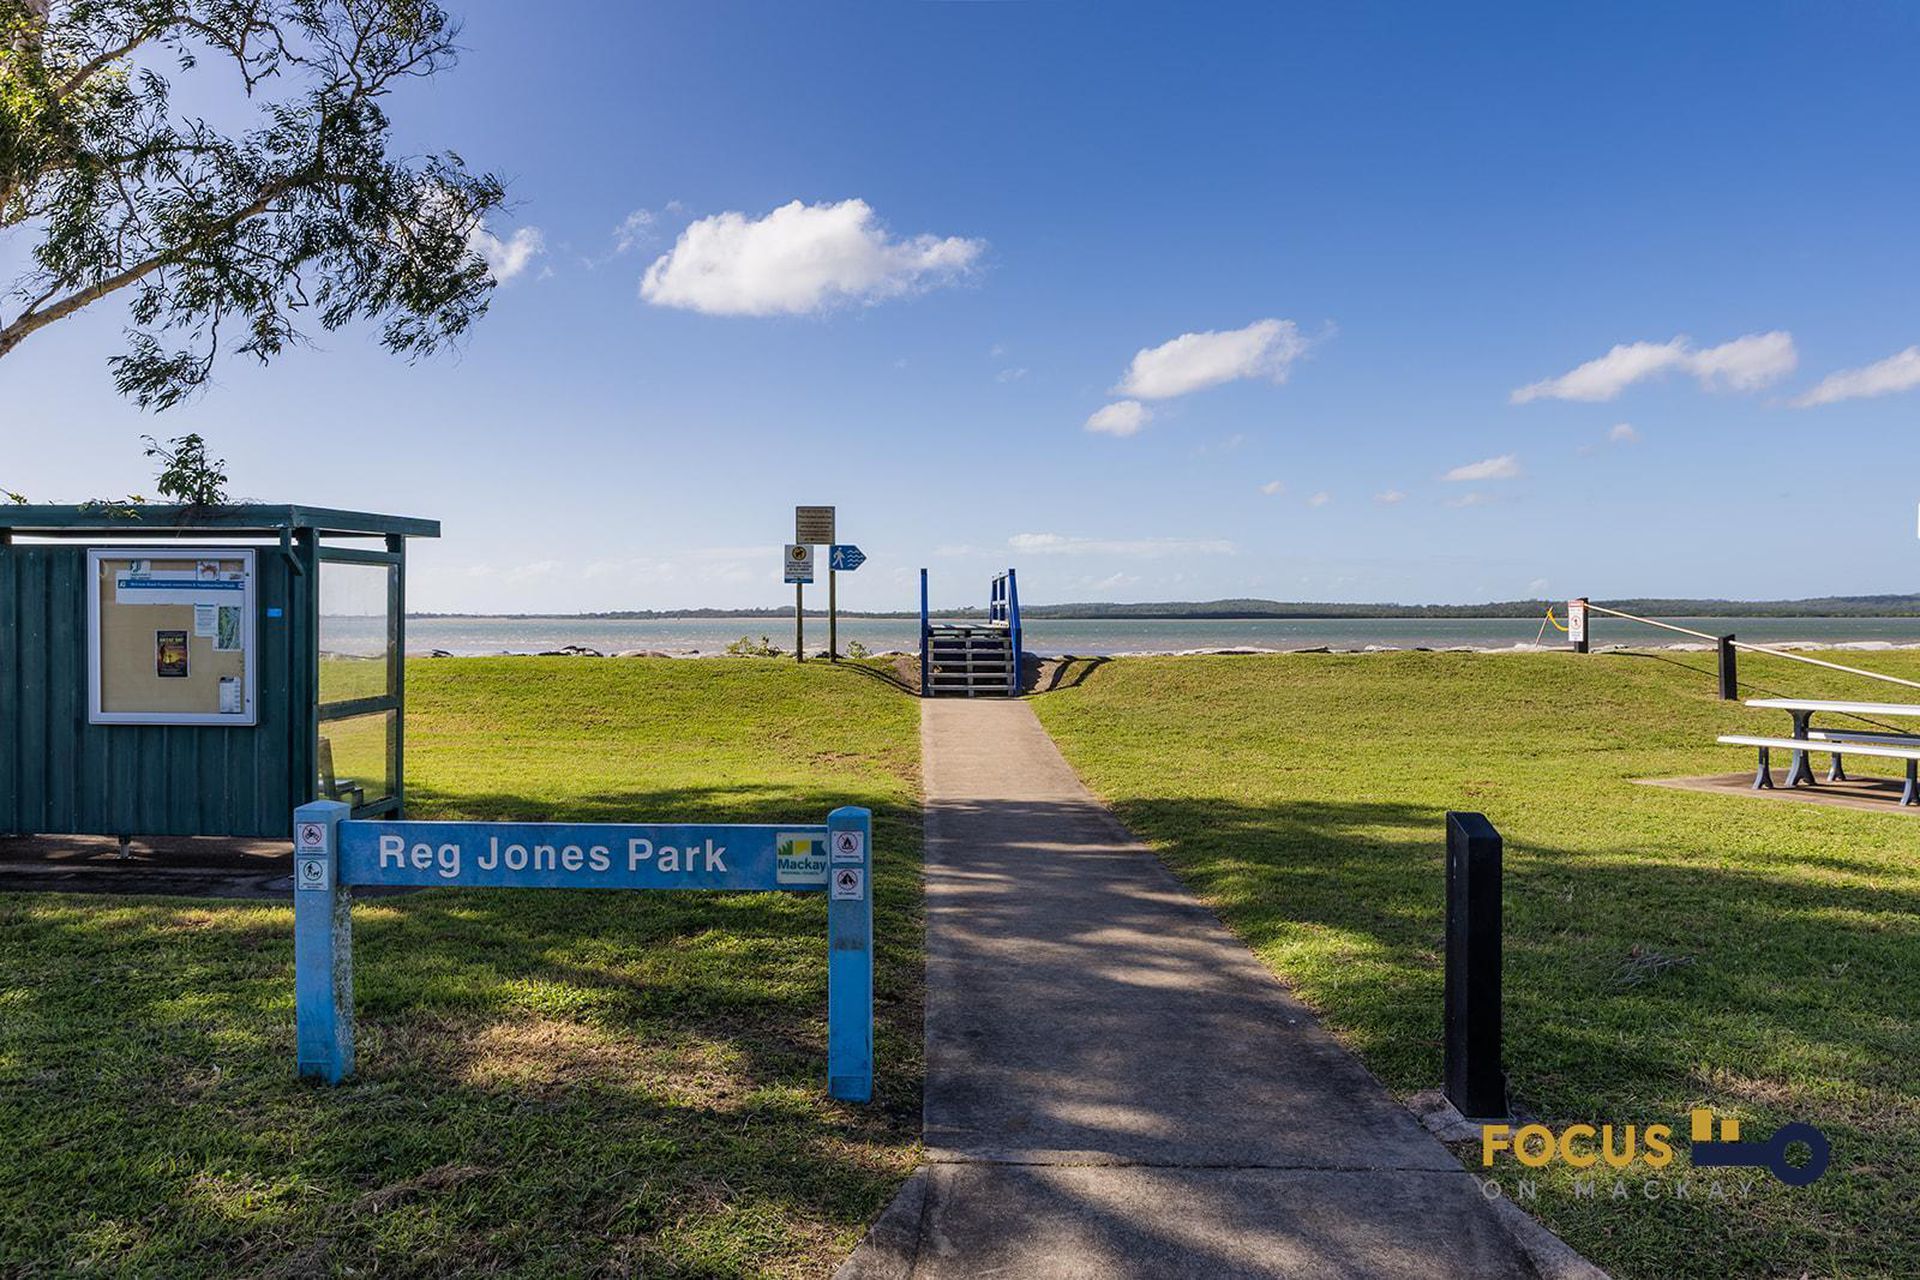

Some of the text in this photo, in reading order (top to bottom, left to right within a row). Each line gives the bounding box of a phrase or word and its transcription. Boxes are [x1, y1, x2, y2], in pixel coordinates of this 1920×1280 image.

[379, 835, 728, 878] Reg Jones Park
[778, 857, 826, 874] Mackay
